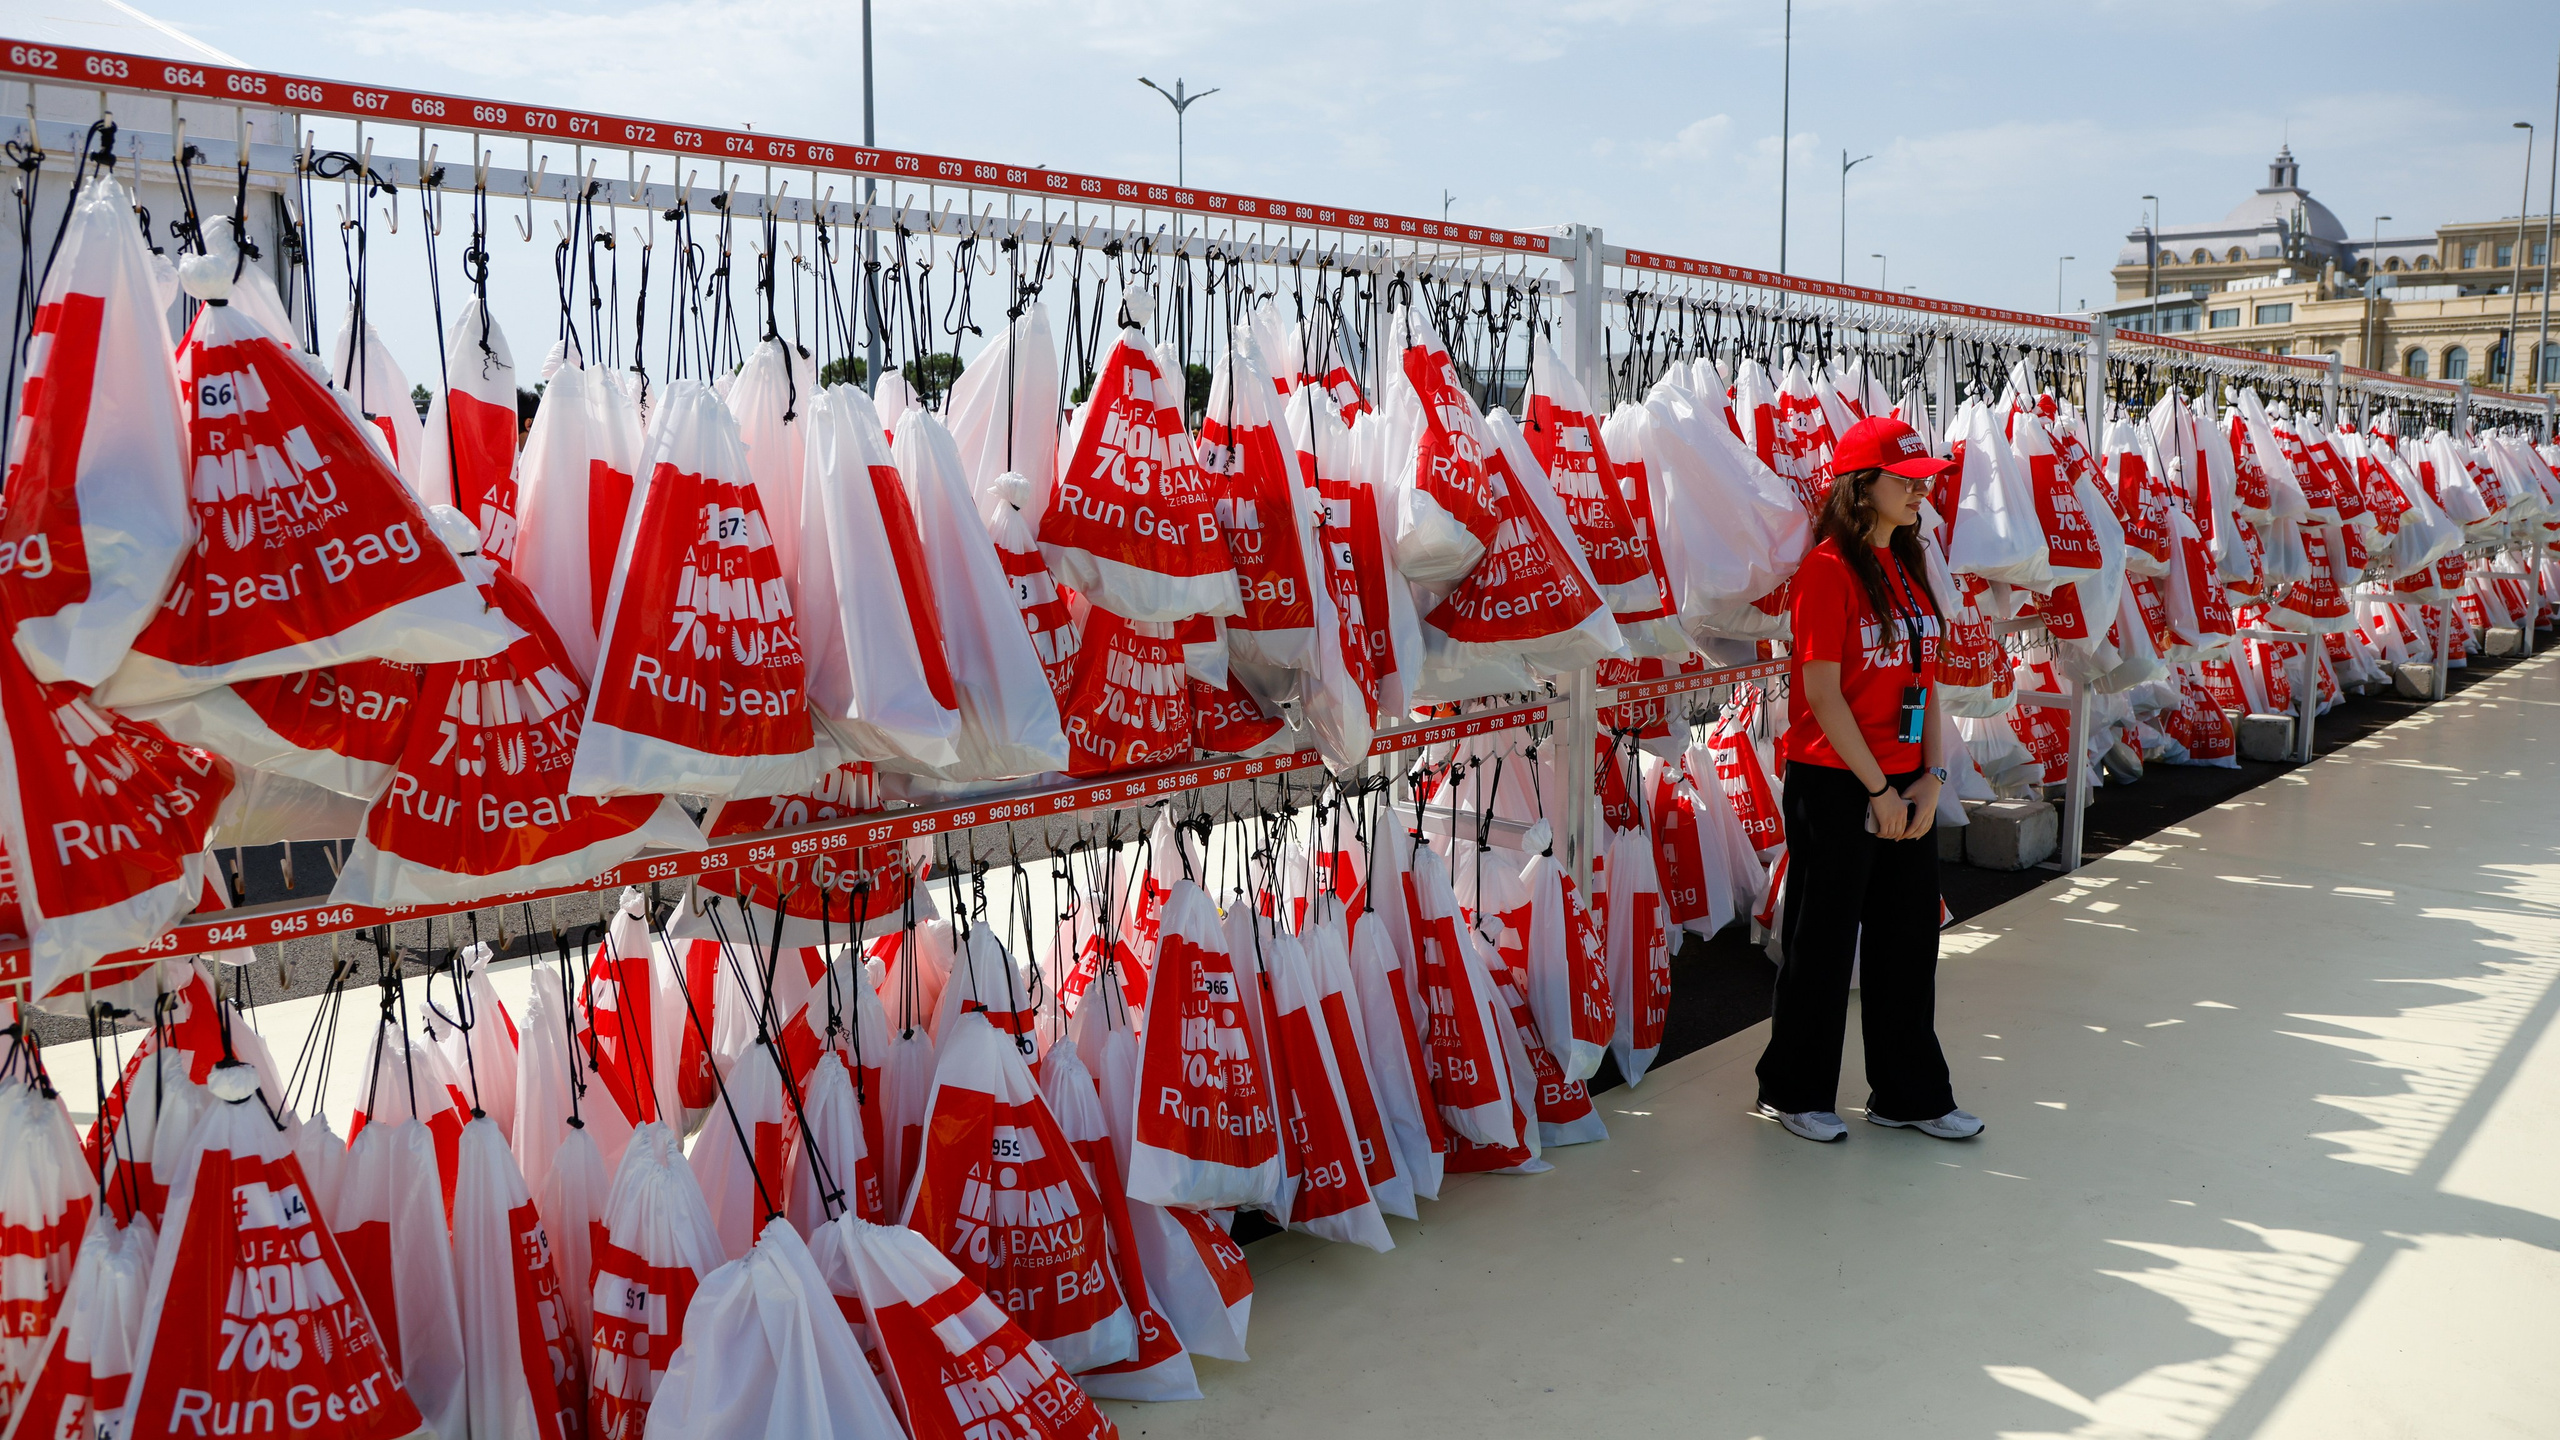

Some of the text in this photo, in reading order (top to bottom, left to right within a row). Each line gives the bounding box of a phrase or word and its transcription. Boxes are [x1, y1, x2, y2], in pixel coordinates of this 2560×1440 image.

[11, 46, 1545, 248] 662 663 664 665 666 667 668 669 670 671 672 673 674 675 676 677 678 679 680 681 682 683 684 685 686 687 688 689 690 691 692 693 694 695 696 697 698 699 700
[1630, 253, 1640, 263] 701
[1649, 256, 1659, 266] 702
[1665, 259, 1675, 269] 703
[1683, 261, 1693, 271] 704
[1698, 264, 1708, 273] 705
[1711, 265, 1721, 275] 706
[1743, 270, 1752, 280] 708
[1759, 273, 1768, 282] 709
[201, 383, 236, 407] 66
[258, 470, 339, 535] BAKU
[1057, 482, 1126, 530] Run
[2050, 534, 2083, 552] Run
[2127, 521, 2157, 541] Run
[315, 521, 423, 584] Bag
[1239, 574, 1297, 607] Bag
[1480, 591, 1543, 622] Gear
[2042, 611, 2076, 629] Bag
[629, 653, 707, 713] Run
[1639, 687, 1649, 696] 982
[1658, 684, 1667, 693] 983
[1776, 663, 1784, 673] 991
[1093, 683, 1146, 729] 70.3
[1620, 703, 1658, 723] Bag
[1065, 714, 1117, 762] Run
[1376, 710, 1544, 751] 973 974 975 976 977 978 979 980
[2209, 737, 2231, 749] Bag
[477, 792, 577, 834] Gear
[1604, 802, 1632, 820] ag
[1742, 815, 1777, 836] Bag
[208, 924, 248, 944] 944
[271, 915, 308, 936] 945
[316, 908, 354, 927] 946
[593, 870, 622, 888] 951
[648, 861, 677, 878] 952
[701, 853, 728, 869] 953
[749, 845, 775, 861] 954
[792, 838, 817, 854] 955
[821, 833, 847, 849] 956
[868, 825, 892, 841] 957
[912, 818, 935, 833] 958
[953, 811, 975, 826] 959
[989, 805, 1011, 820] 960
[1013, 802, 1034, 816] 961
[1054, 795, 1074, 809] 962
[1091, 788, 1111, 802] 963
[1126, 782, 1145, 795] 964
[1157, 776, 1176, 790] 965
[1179, 773, 1197, 786] 966
[1213, 767, 1231, 780] 967
[1245, 761, 1262, 774] 968
[1275, 756, 1291, 768] 969
[1302, 752, 1318, 765] 970
[1542, 1079, 1585, 1106] Bag
[1010, 1218, 1085, 1256] BAKU
[1013, 1243, 1086, 1269] AZERBAIJAN
[1211, 1240, 1246, 1271] Ru
[1055, 1258, 1107, 1306] Bag
[217, 1315, 304, 1372] 70.3
[167, 1370, 383, 1437] Run Gear
